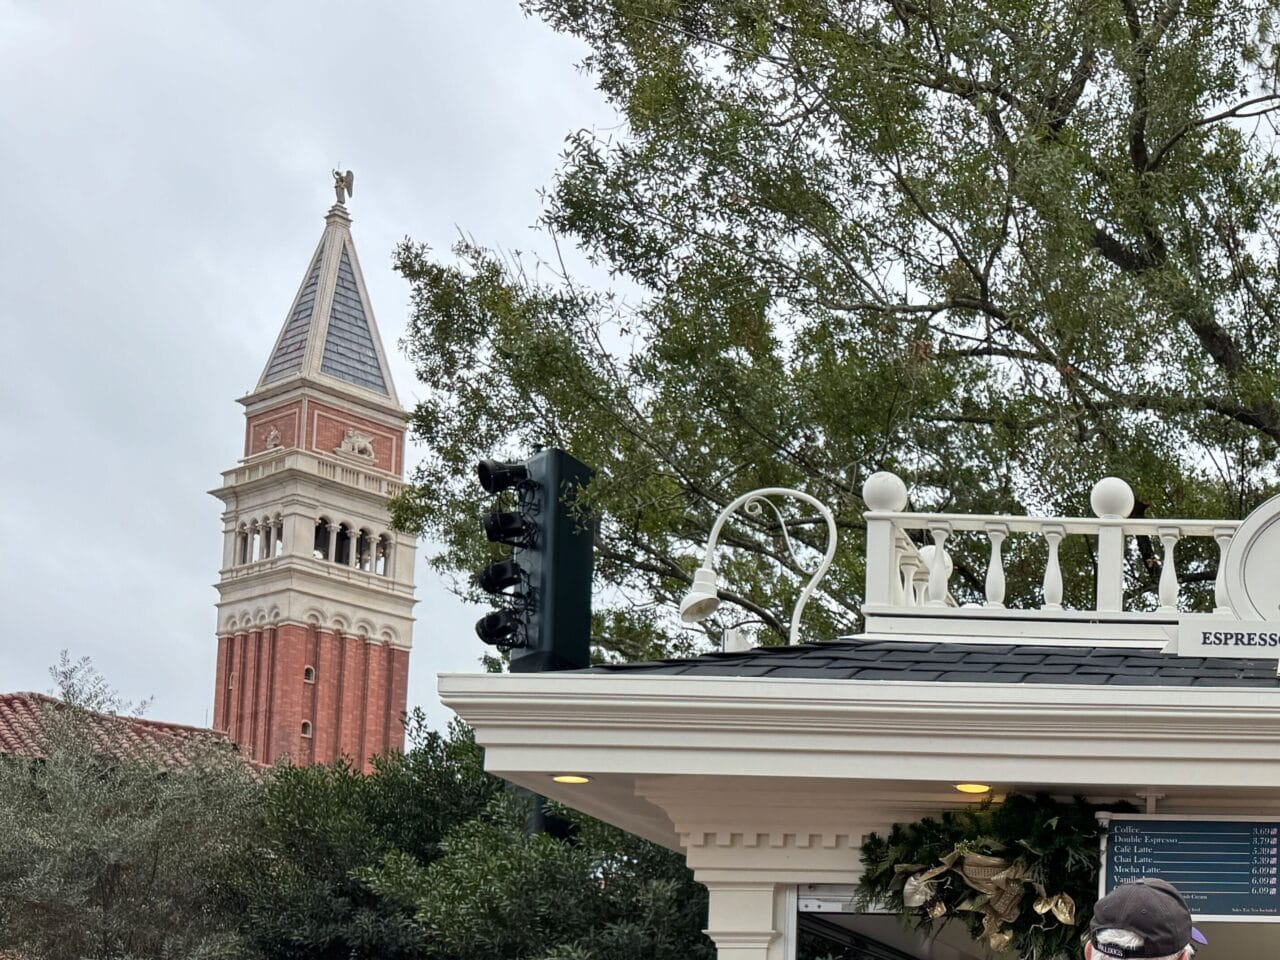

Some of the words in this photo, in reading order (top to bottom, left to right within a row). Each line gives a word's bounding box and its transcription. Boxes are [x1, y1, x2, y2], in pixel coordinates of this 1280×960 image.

[1114, 835, 1143, 844] Double
[1145, 836, 1178, 845] Espresso
[1252, 838, 1269, 846] 3.79
[1114, 845, 1131, 853] Café
[1252, 847, 1269, 855] 5.39
[1114, 855, 1132, 863] Chai
